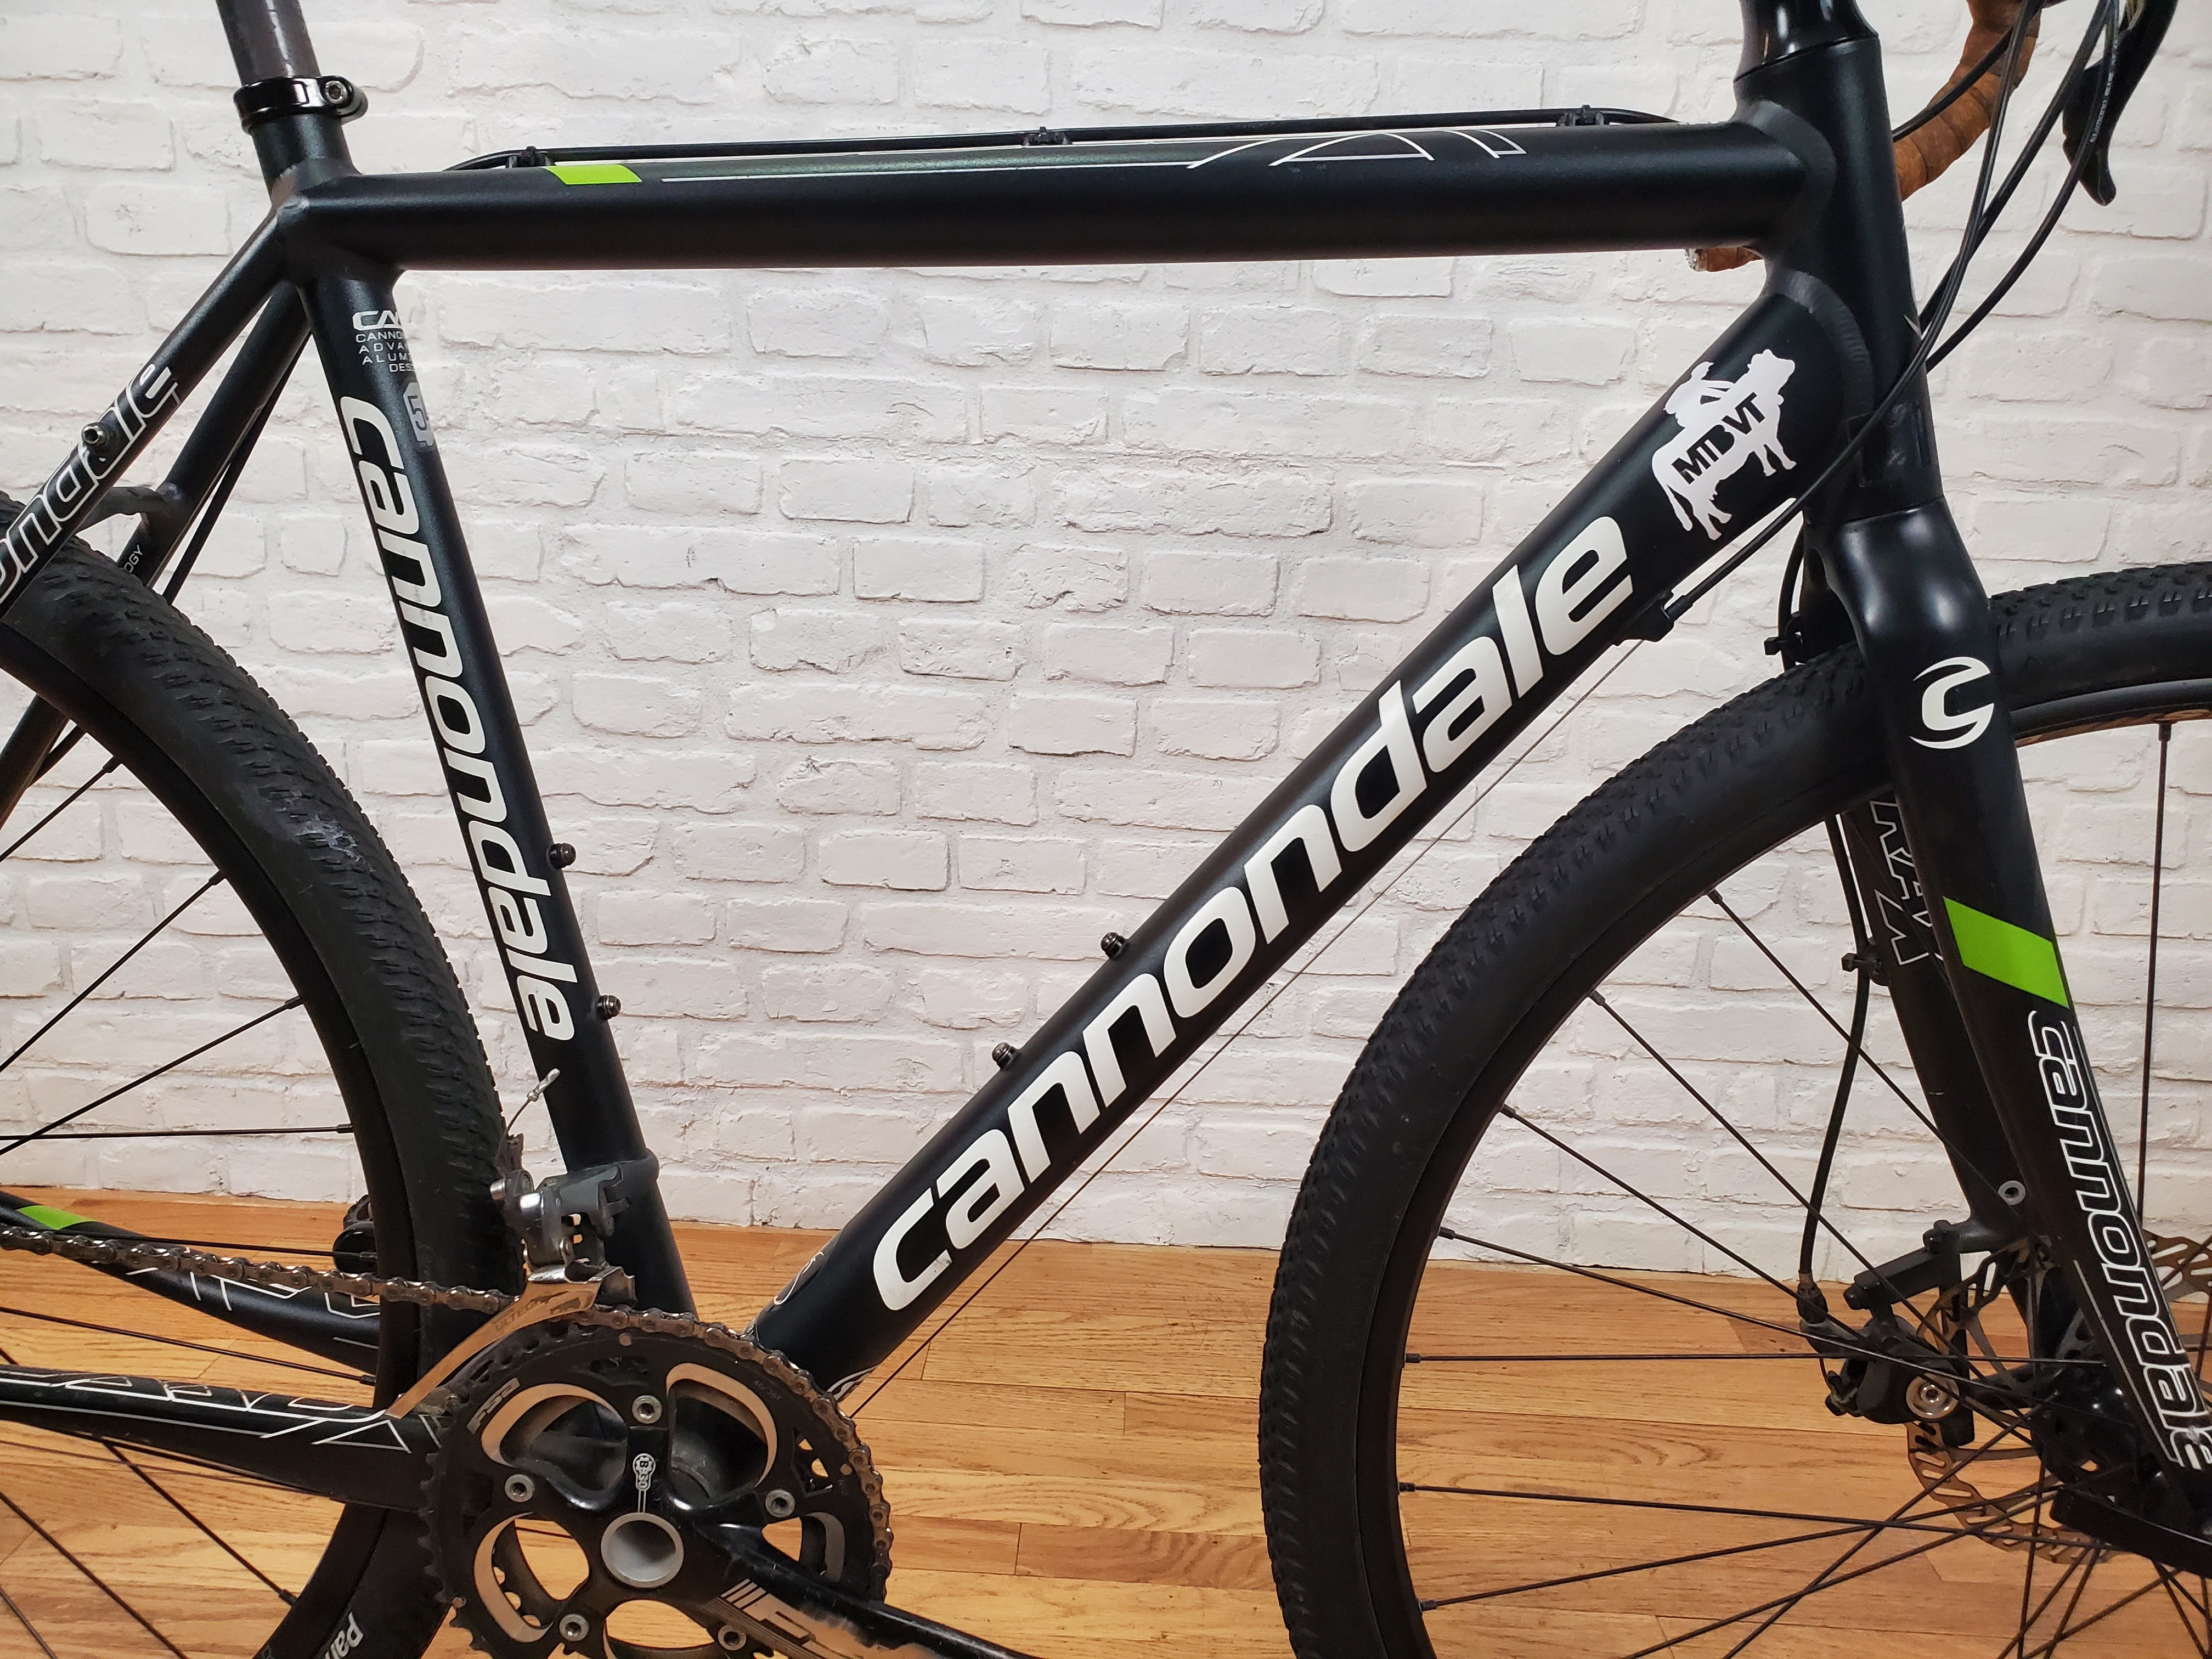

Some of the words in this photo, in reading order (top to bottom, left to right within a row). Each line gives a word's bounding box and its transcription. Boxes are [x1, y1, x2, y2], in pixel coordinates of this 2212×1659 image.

[389, 363, 415, 373] DES
[340, 396, 578, 1041] cannondale
[873, 515, 1634, 1310] cannondale
